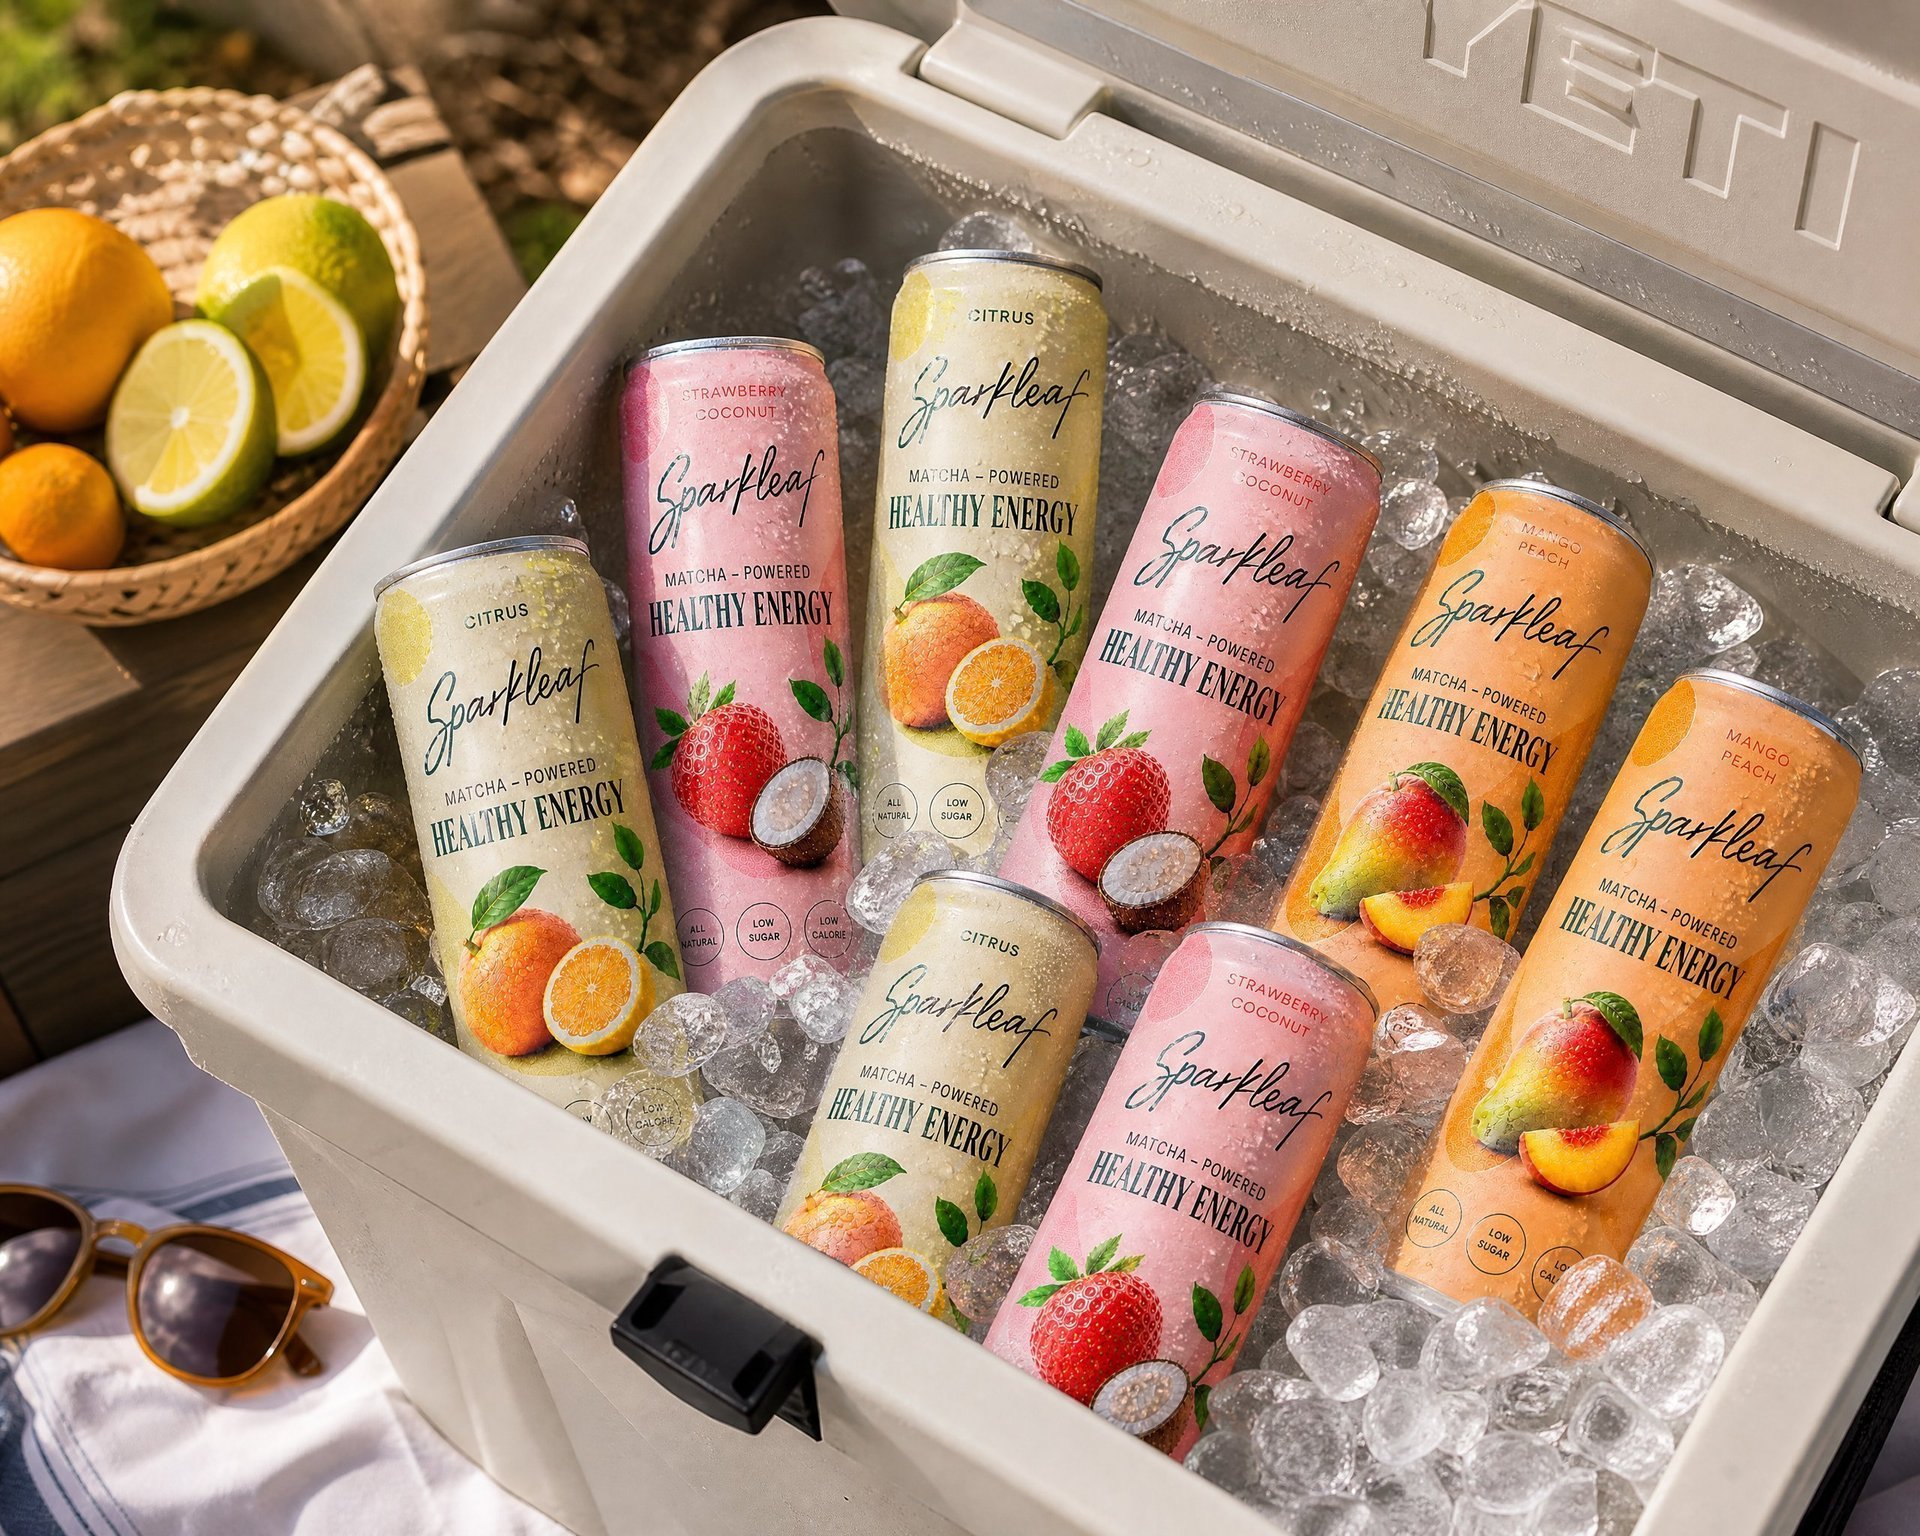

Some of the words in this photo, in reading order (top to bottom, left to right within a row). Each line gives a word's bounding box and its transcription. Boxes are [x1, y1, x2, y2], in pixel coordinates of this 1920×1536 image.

[968, 309, 1034, 325] CITRUS
[682, 385, 785, 401] STRAWBERRY
[898, 356, 1090, 448] Sparkleaf
[695, 406, 776, 421] COCONUT
[909, 468, 969, 483] MATCHA
[989, 469, 1059, 489] POWERED
[1229, 446, 1332, 496] STRAWBERRY
[1233, 470, 1313, 510] COCONUT
[649, 445, 825, 555] Sparkleaf
[889, 494, 986, 530] HEALTHY
[991, 494, 1078, 536] ENERGY
[1518, 541, 1569, 570] PEACH
[1521, 523, 1582, 555] MANGO
[665, 568, 726, 587] MATCHA
[744, 564, 810, 580] POWERED
[1134, 506, 1340, 623] Sparkleaf
[464, 603, 528, 629] CITRUS
[649, 592, 746, 637] HEALTHY
[755, 590, 832, 625] ENERGY
[1411, 569, 1609, 680] Sparkleaf
[1134, 609, 1191, 639] MATCHA
[1208, 634, 1275, 673] POWERED
[1099, 628, 1202, 688] HEALTHY
[1196, 662, 1287, 727] ENERGY
[1412, 667, 1466, 693] MATCHA
[1482, 687, 1546, 725] POWERED
[425, 639, 599, 775] Sparkleaf
[1377, 688, 1475, 738] HEALTHY
[1470, 711, 1558, 776] ENERGY
[1726, 728, 1790, 767] MANGO
[445, 778, 506, 806] MATCHA
[524, 758, 596, 786] POWERED
[1721, 750, 1776, 784] PEACH
[431, 800, 528, 857] HEALTHY
[534, 779, 625, 831] ENERGY
[878, 812, 910, 820] NATURAL
[887, 799, 901, 807] ALL
[941, 812, 972, 820] SUGAR
[947, 799, 968, 807] LOW
[1600, 776, 1812, 902] Sparkleaf
[690, 925, 705, 933] ALL
[753, 919, 774, 928] LOW
[820, 917, 838, 925] LOW
[1599, 878, 1657, 913] MATCHA
[1671, 908, 1738, 950] POWERED
[681, 937, 717, 948] NATURAL
[749, 933, 779, 942] SUGAR
[812, 931, 846, 939] CALORIE
[960, 930, 1020, 957] CITRUS
[1560, 896, 1662, 962] HEALTHY
[1655, 934, 1746, 1000] ENERGY
[860, 964, 1057, 1068] Sparkleaf
[1227, 973, 1329, 1025] STRAWBERRY
[1231, 997, 1311, 1038] COCONUT
[643, 1104, 664, 1114] LOW
[860, 1065, 915, 1088] MATCHA
[931, 1081, 999, 1117] POWERED
[1124, 1030, 1332, 1151] Sparkleaf
[827, 1087, 925, 1134] HEALTHY
[921, 1106, 1012, 1169] ENERGY
[1126, 1132, 1186, 1163] MATCHA
[1202, 1158, 1266, 1201] POWERED
[1087, 1150, 1195, 1212] HEALTHY
[1189, 1184, 1274, 1256] ENERGY
[1429, 1205, 1444, 1217] ALL
[1412, 1215, 1449, 1234] NATURAL
[1489, 1228, 1512, 1244] LOW
[1477, 1240, 1510, 1261] SUGAR
[1554, 1260, 1570, 1272] LO
